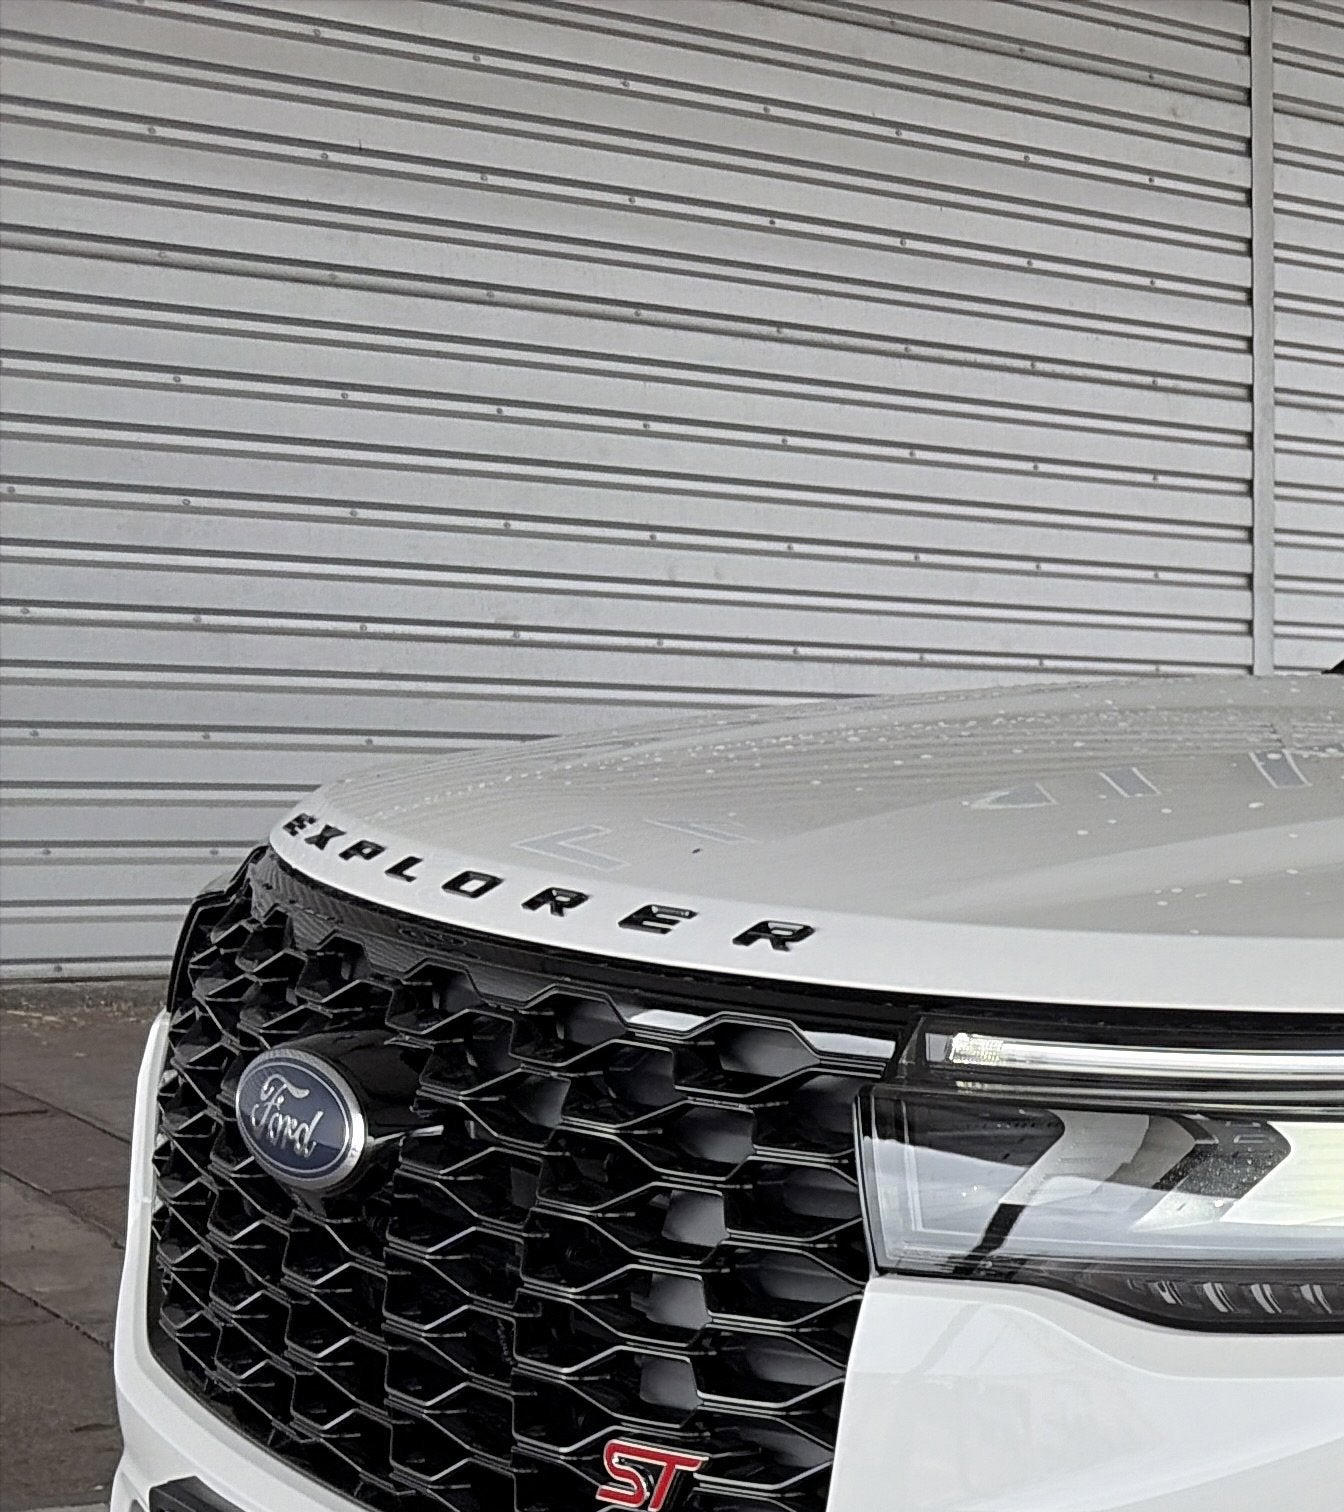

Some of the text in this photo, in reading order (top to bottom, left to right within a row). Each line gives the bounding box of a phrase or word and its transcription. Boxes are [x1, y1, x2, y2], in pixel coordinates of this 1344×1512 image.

[281, 811, 817, 952] EXPLORER
[251, 1075, 322, 1156] Ford
[596, 1437, 709, 1512] ST
